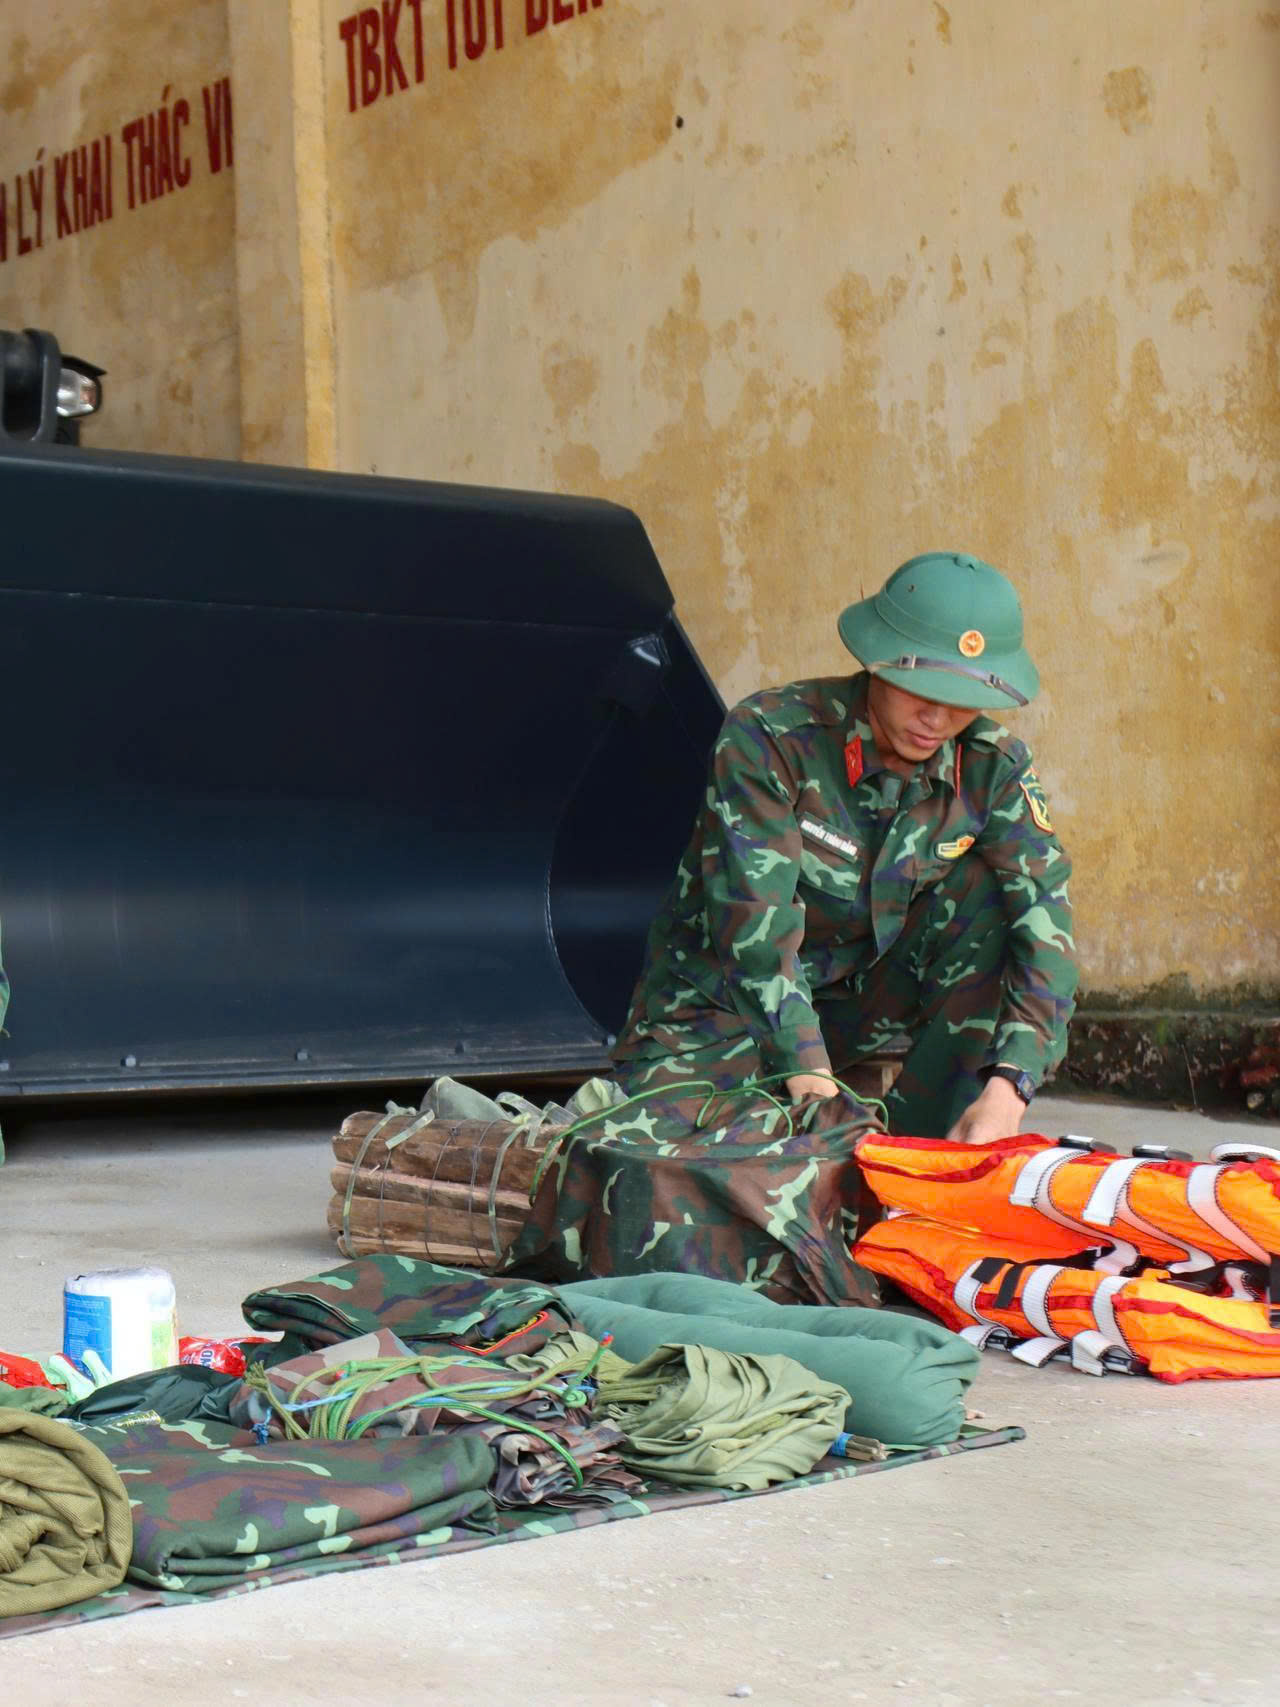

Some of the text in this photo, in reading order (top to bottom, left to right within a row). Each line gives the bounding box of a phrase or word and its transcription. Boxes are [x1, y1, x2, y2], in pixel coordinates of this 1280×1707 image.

[339, 0, 424, 113] TBKT
[16, 147, 44, 256] LÝ
[54, 134, 113, 240] KHAI
[122, 83, 192, 210] THÁC
